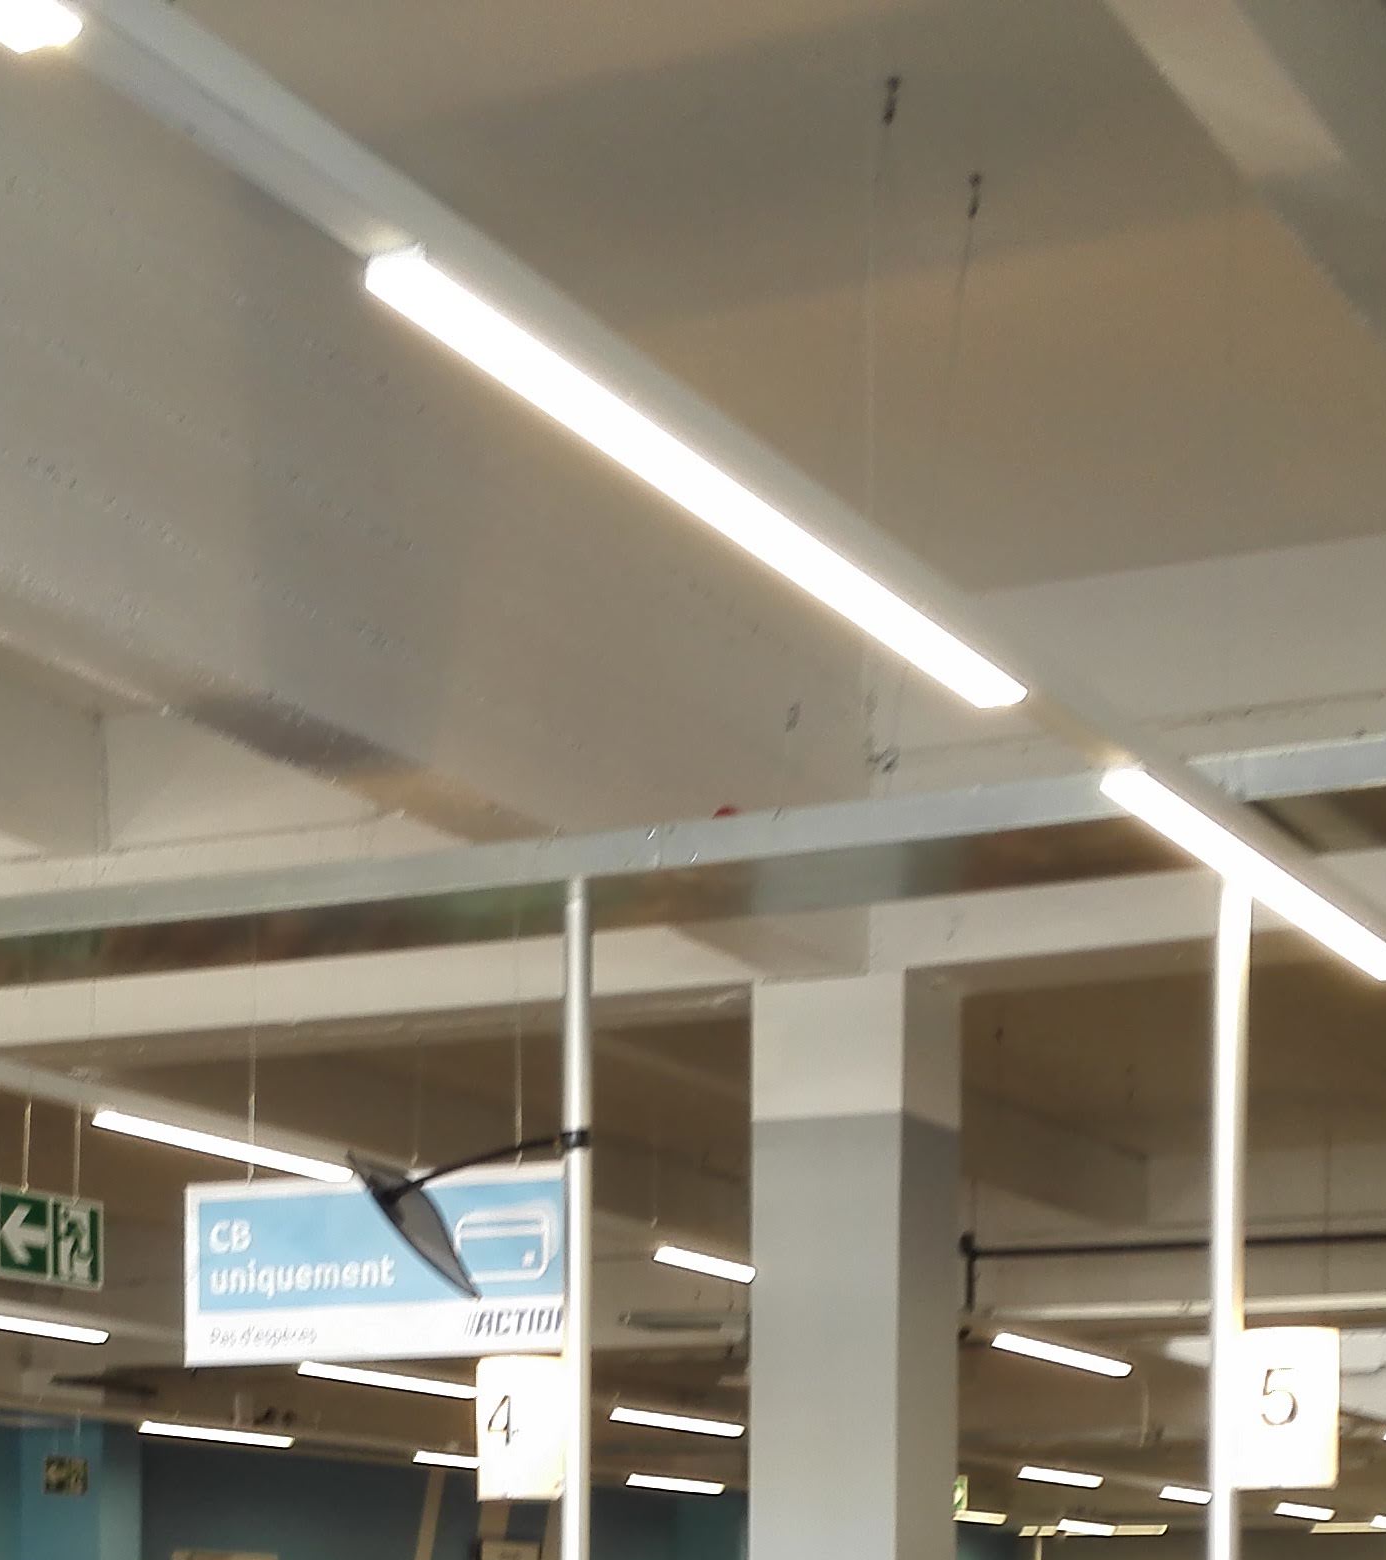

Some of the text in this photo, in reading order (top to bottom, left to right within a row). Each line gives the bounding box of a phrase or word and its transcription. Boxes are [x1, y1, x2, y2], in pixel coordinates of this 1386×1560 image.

[209, 1218, 252, 1254] CB
[210, 1254, 395, 1300] uniquement
[487, 1394, 518, 1446] 4
[1261, 1367, 1299, 1426] 5
